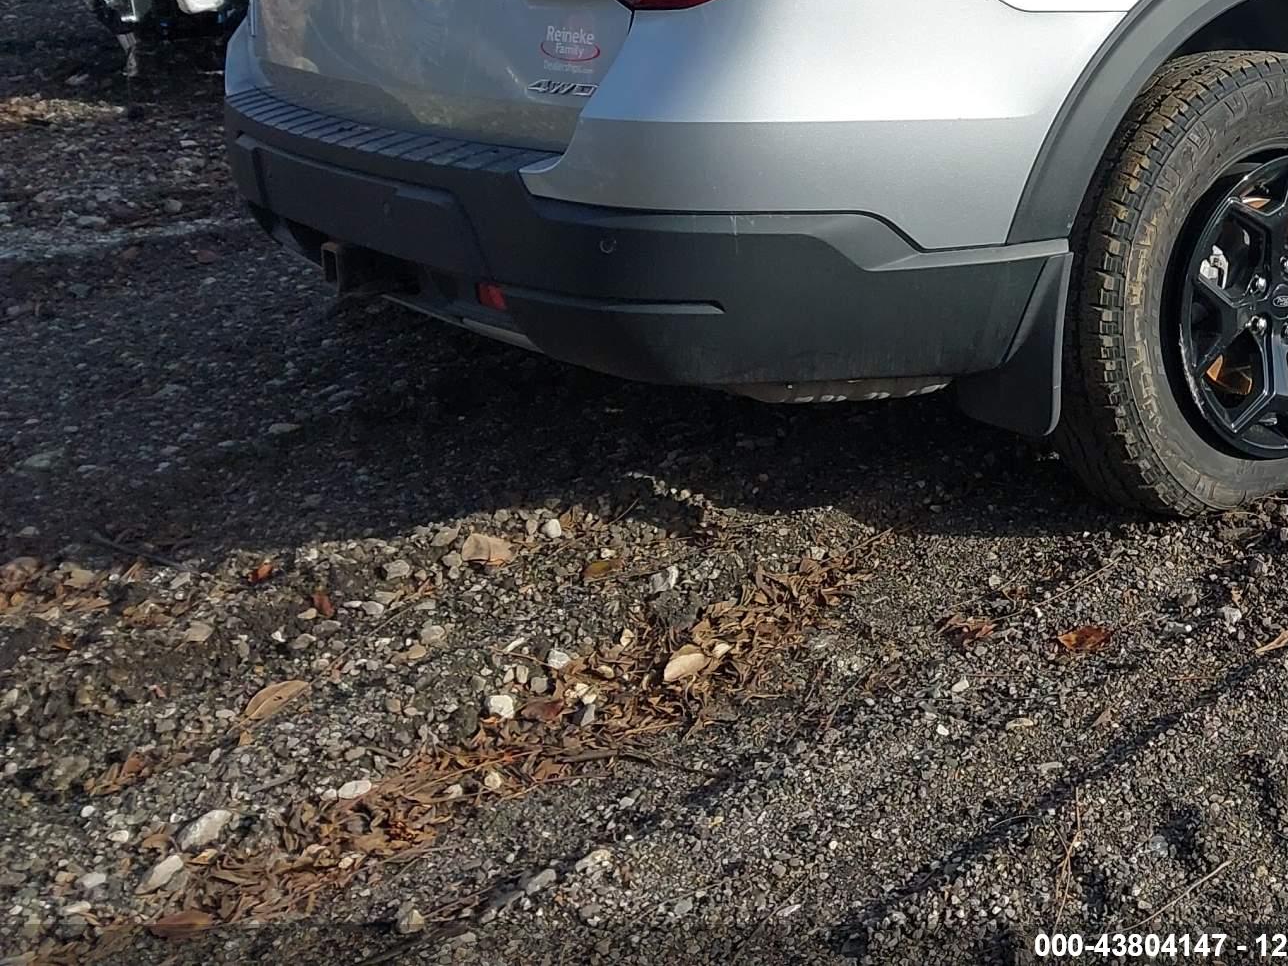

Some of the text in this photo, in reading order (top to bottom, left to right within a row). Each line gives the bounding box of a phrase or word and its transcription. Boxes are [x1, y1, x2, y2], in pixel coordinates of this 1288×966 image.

[546, 25, 595, 44] Reineke
[556, 42, 585, 59] Family
[528, 79, 599, 97] 4WD
